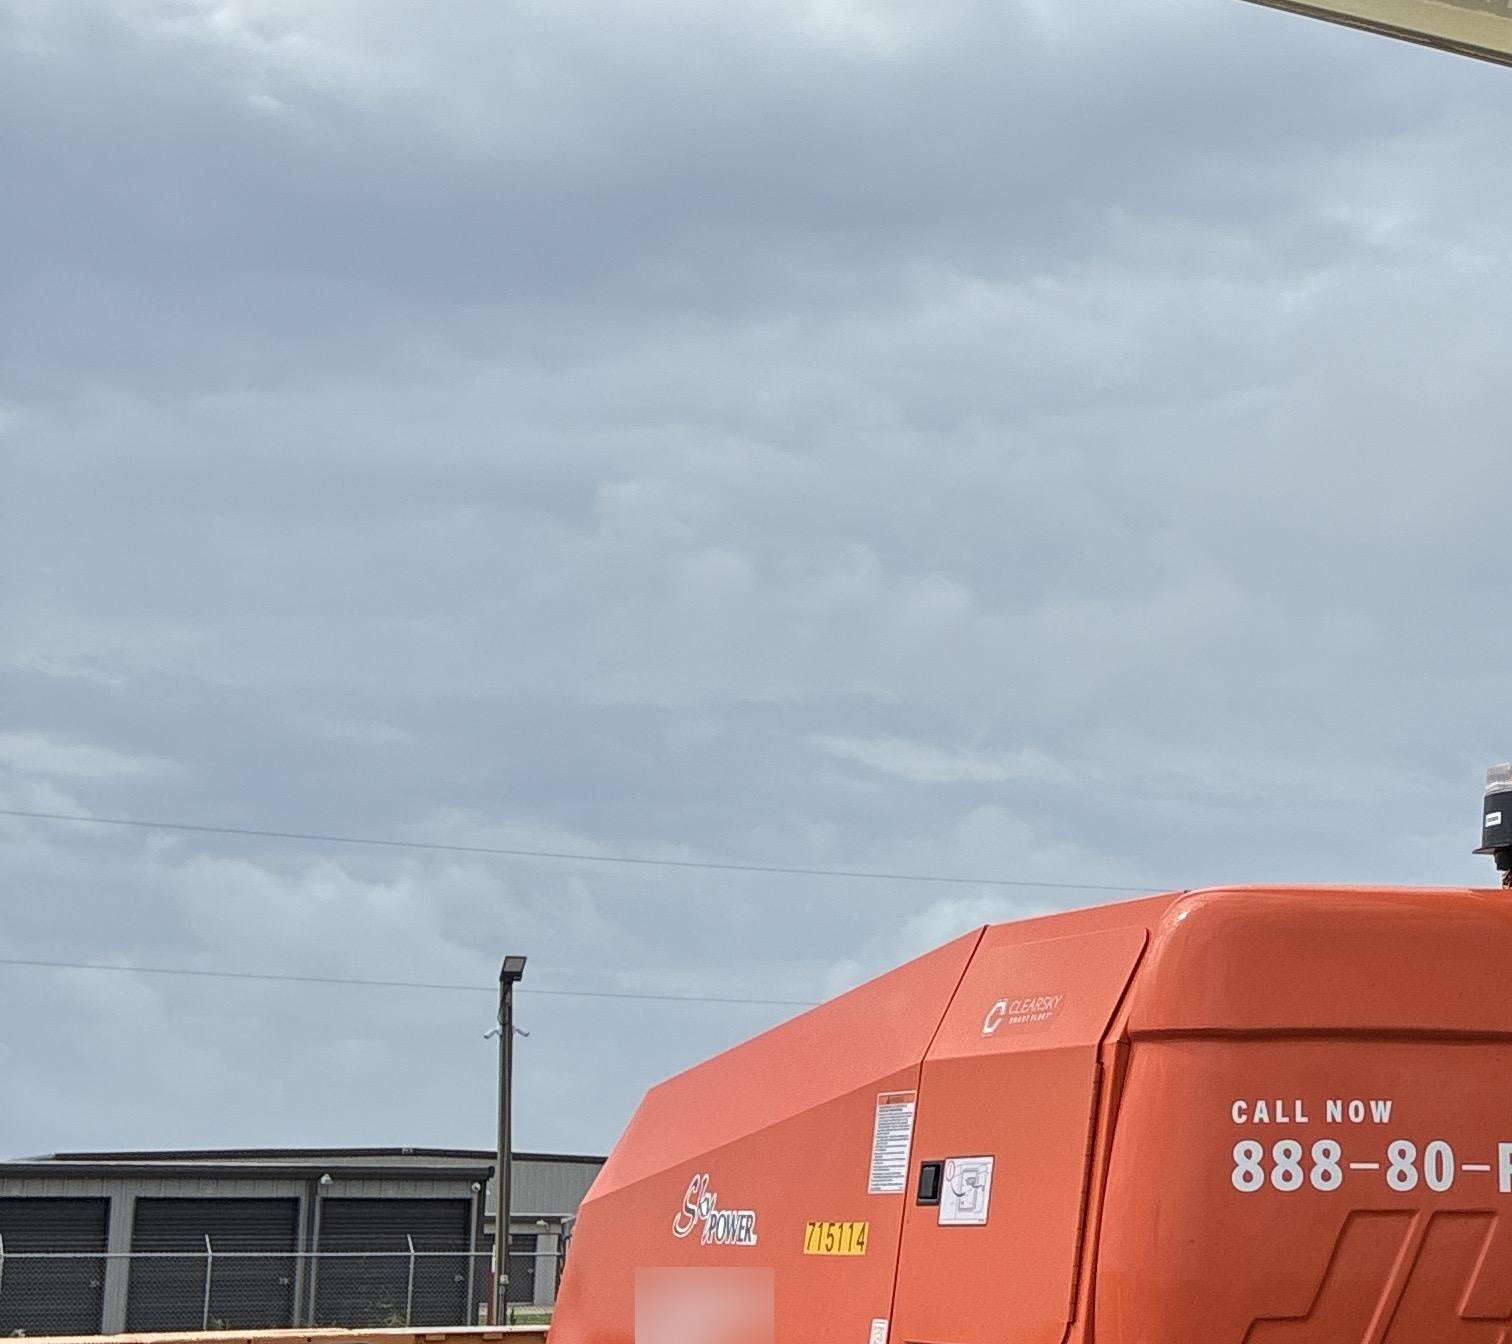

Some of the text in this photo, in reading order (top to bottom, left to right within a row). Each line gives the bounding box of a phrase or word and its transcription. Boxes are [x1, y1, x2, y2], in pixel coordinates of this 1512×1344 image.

[1230, 1099, 1393, 1125] CALL NOW
[706, 1211, 757, 1245] POWER
[806, 1222, 867, 1252] 715114
